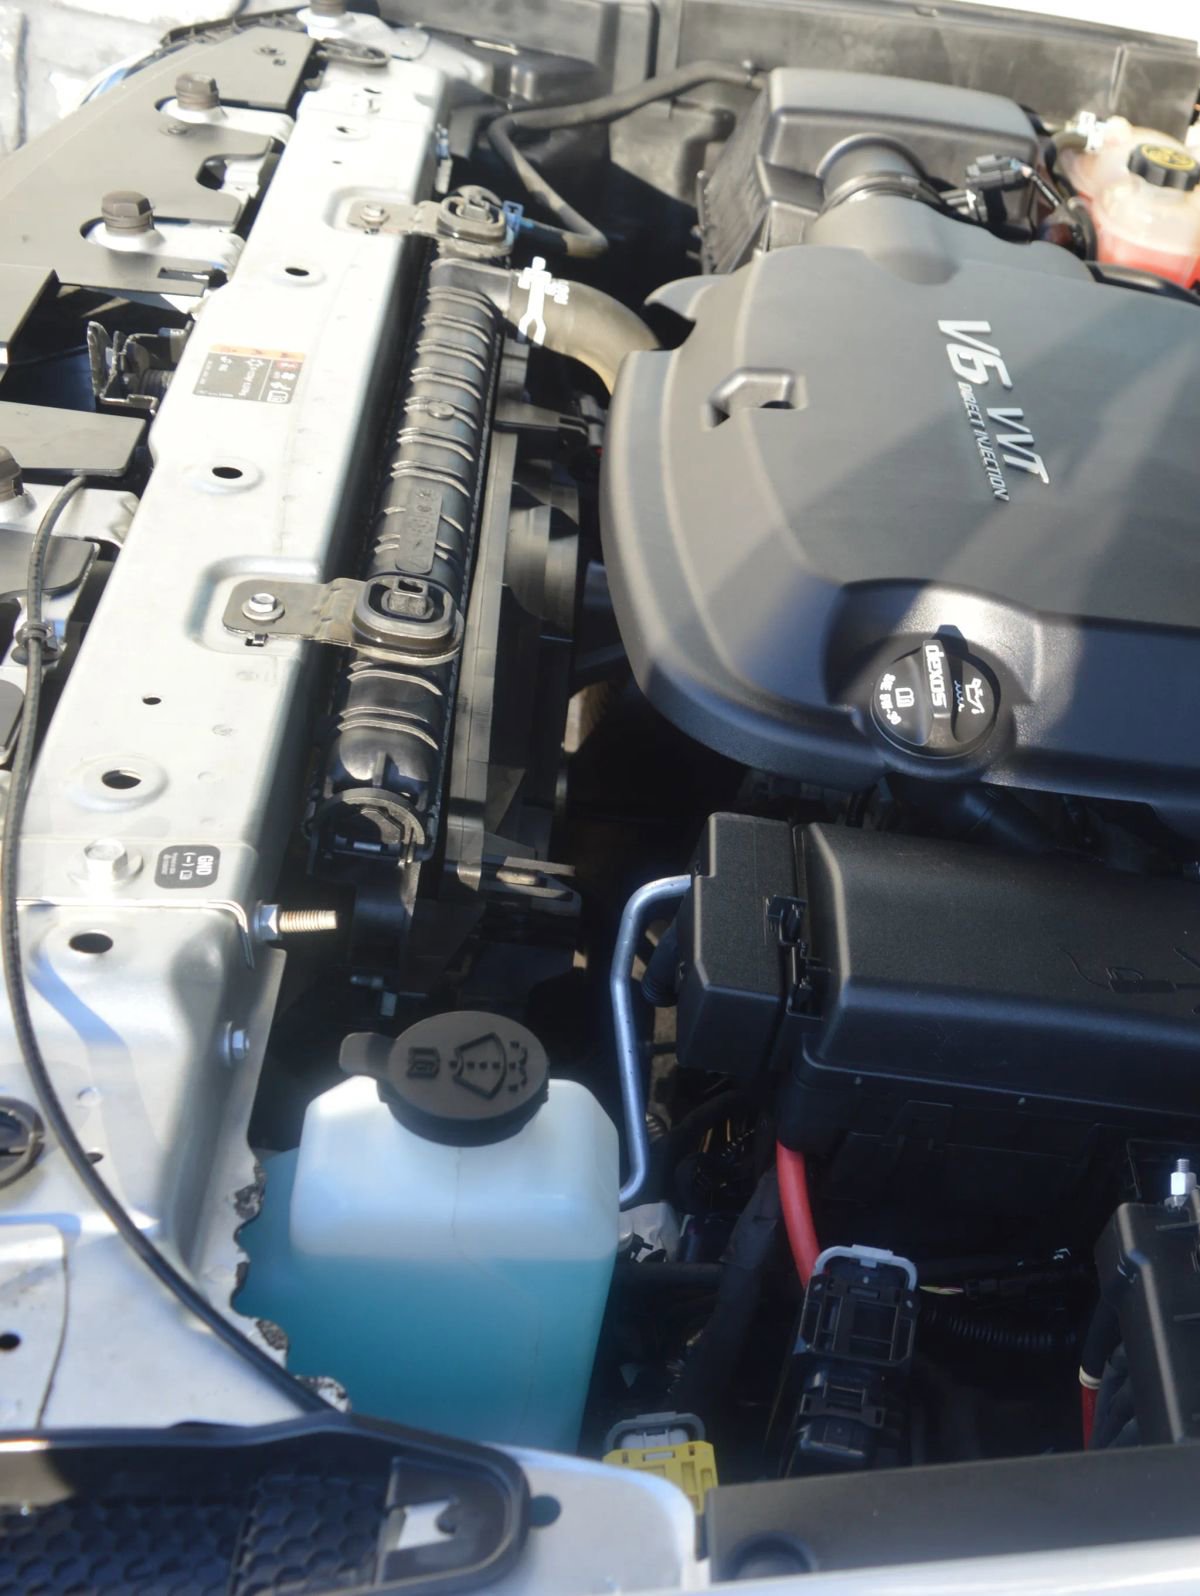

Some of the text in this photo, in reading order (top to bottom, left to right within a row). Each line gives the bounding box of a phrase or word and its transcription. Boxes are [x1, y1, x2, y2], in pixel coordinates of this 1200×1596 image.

[938, 320, 1050, 484] V6 VVT
[958, 381, 1010, 501] DIRECT INJECTION
[925, 645, 948, 709] dexos
[196, 855, 214, 875] GND
